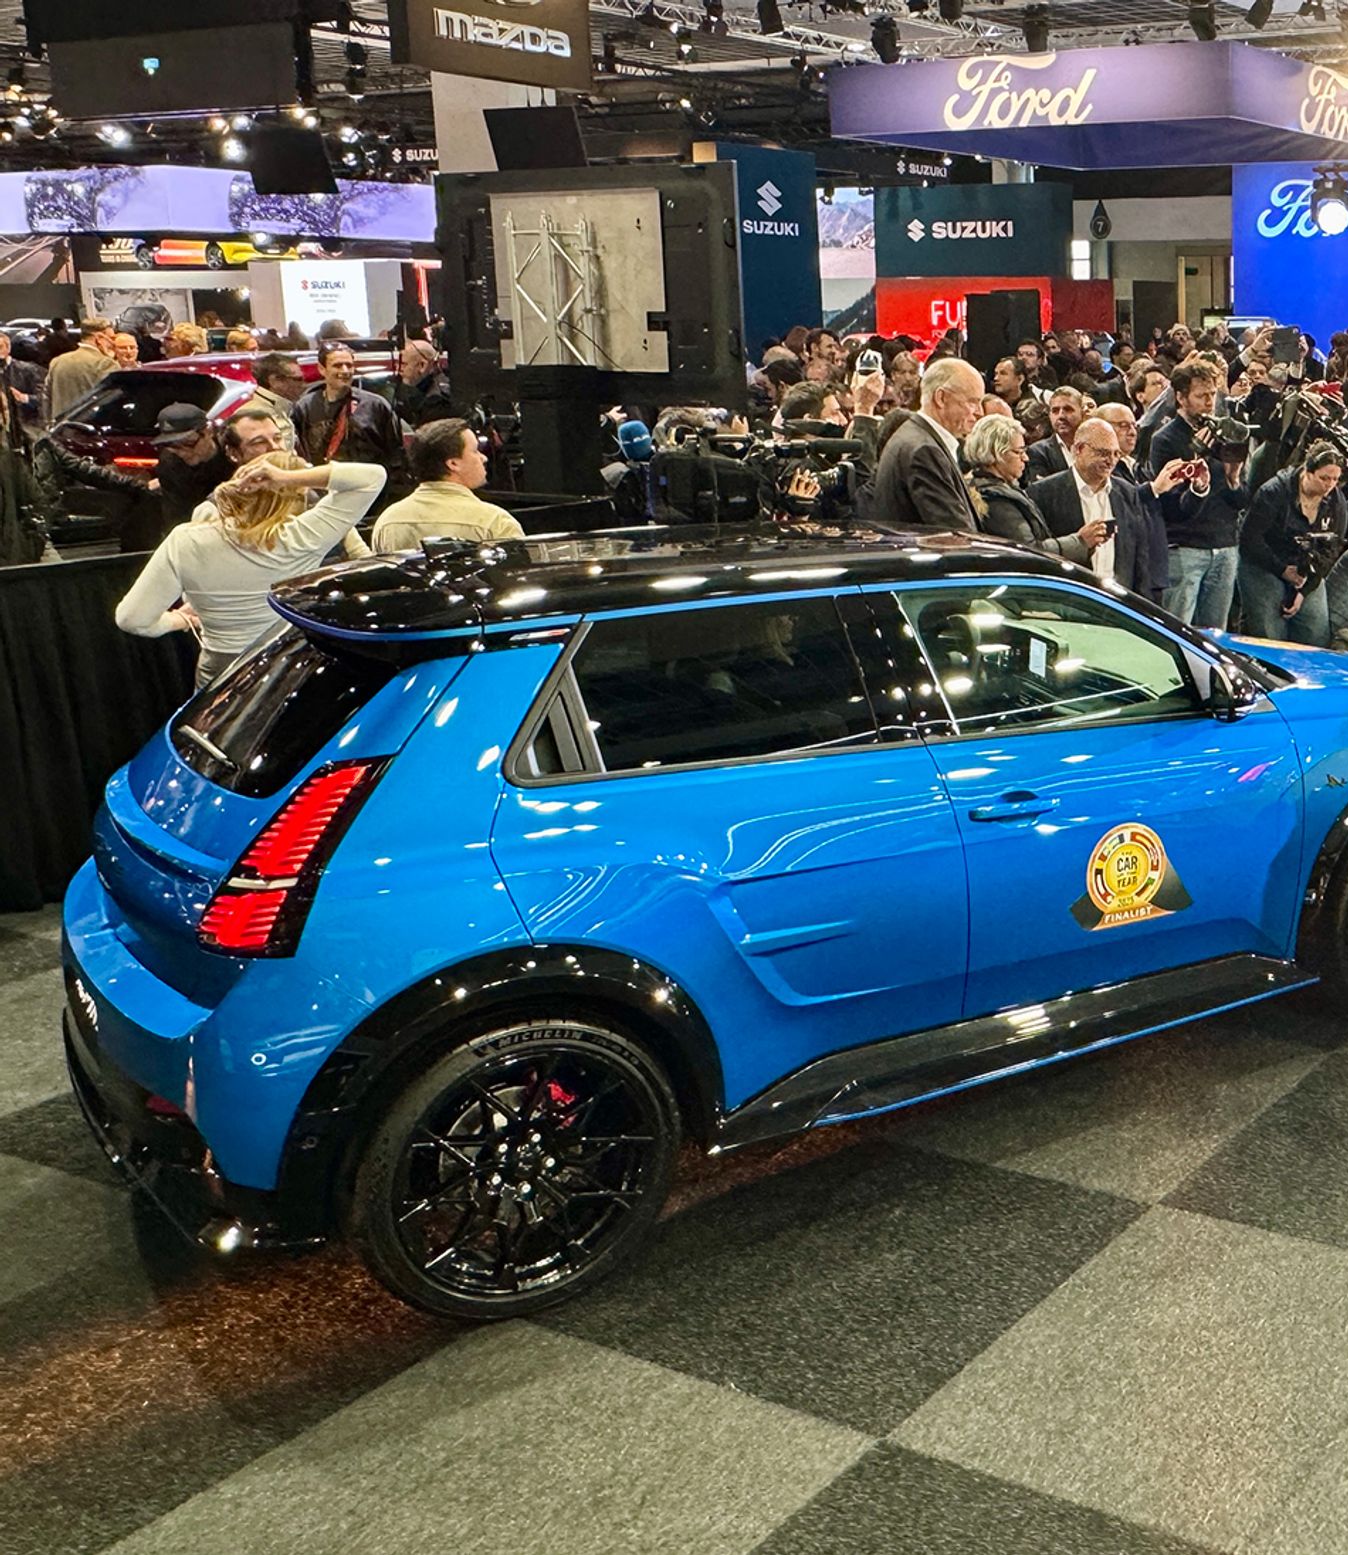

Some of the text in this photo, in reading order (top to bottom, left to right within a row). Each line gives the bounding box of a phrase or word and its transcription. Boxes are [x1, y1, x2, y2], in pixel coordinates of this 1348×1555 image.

[943, 53, 1097, 131] Ford
[405, 148, 439, 161] SUZU
[908, 162, 948, 178] SUZUKI
[742, 219, 799, 237] SUZUKI
[931, 220, 1014, 239] SUZUKI
[1096, 221, 1104, 233] 7
[1116, 855, 1138, 872] CAR
[1117, 876, 1138, 889] YEAR
[1105, 904, 1152, 923] FINALIST
[497, 1028, 584, 1048] MICHELIN
